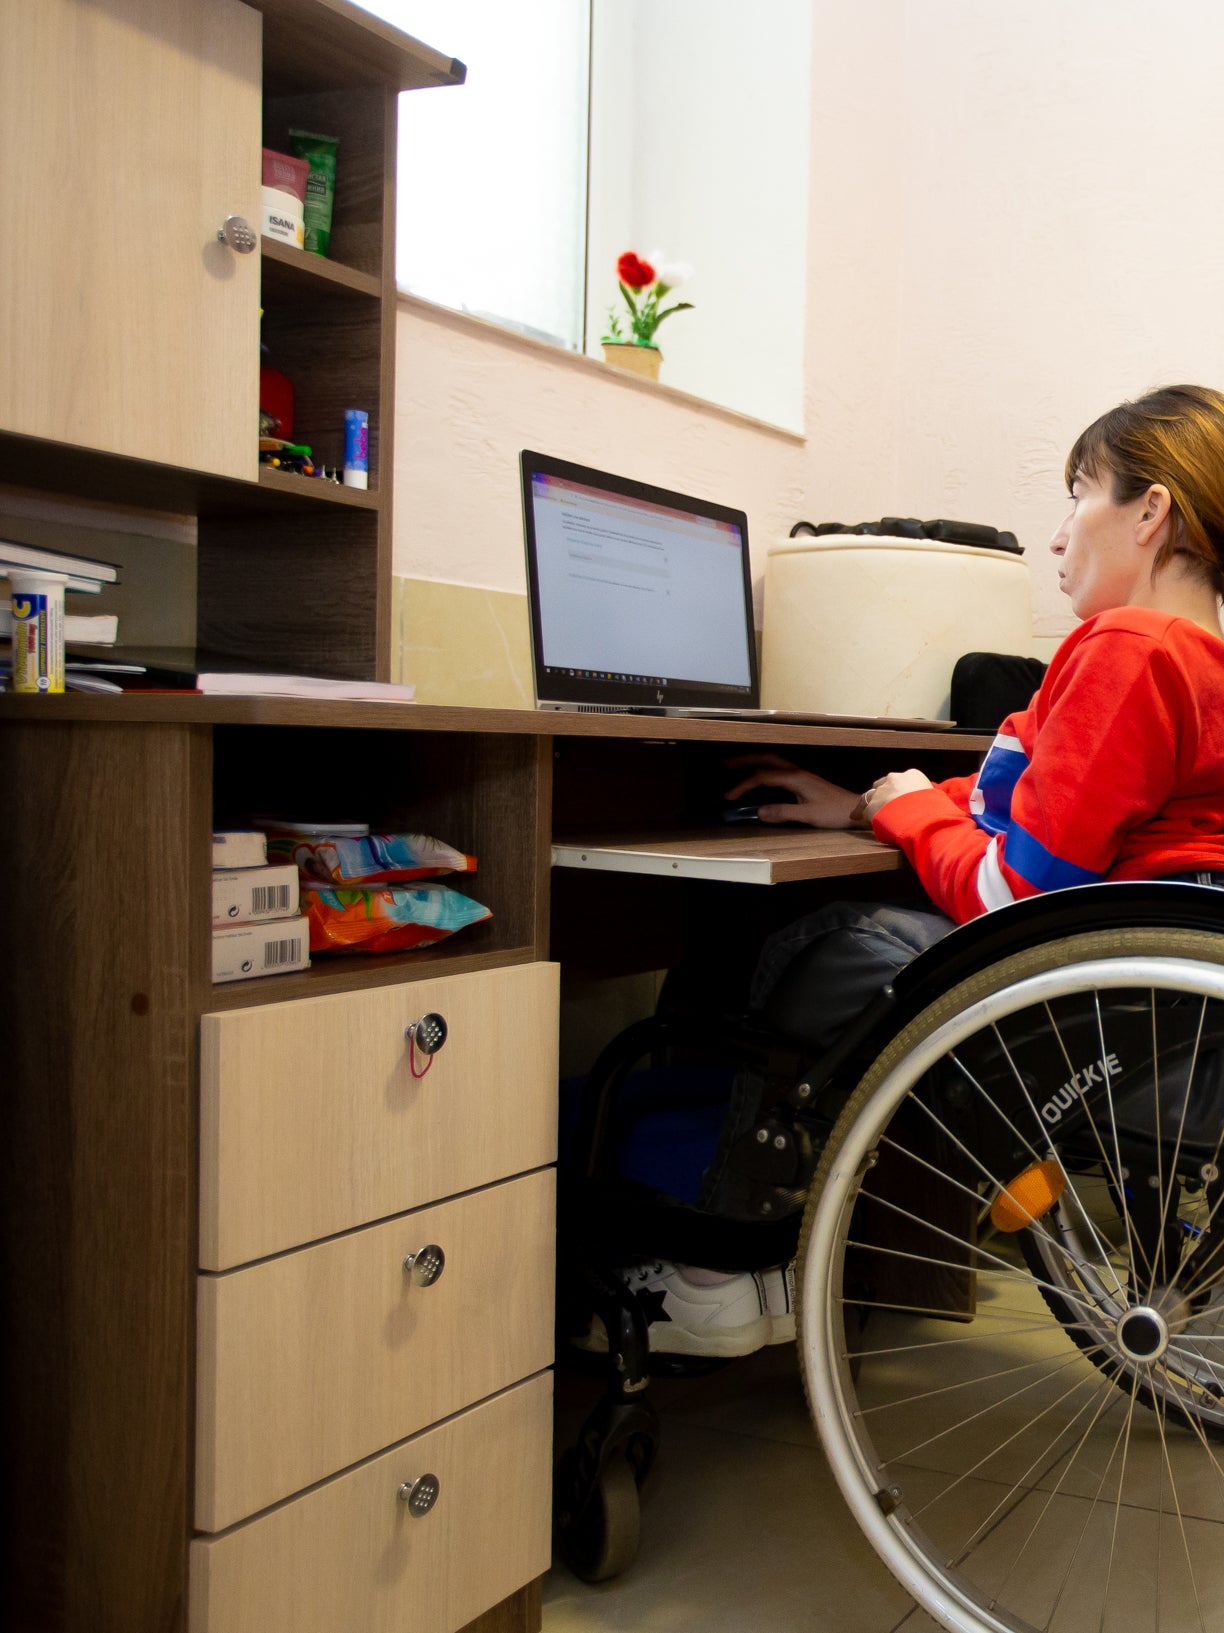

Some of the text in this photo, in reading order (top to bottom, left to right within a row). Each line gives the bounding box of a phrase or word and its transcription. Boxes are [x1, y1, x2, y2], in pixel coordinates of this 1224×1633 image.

[269, 215, 295, 231] ISANA
[13, 600, 31, 618] C
[1041, 1053, 1123, 1124] QUICKIE
